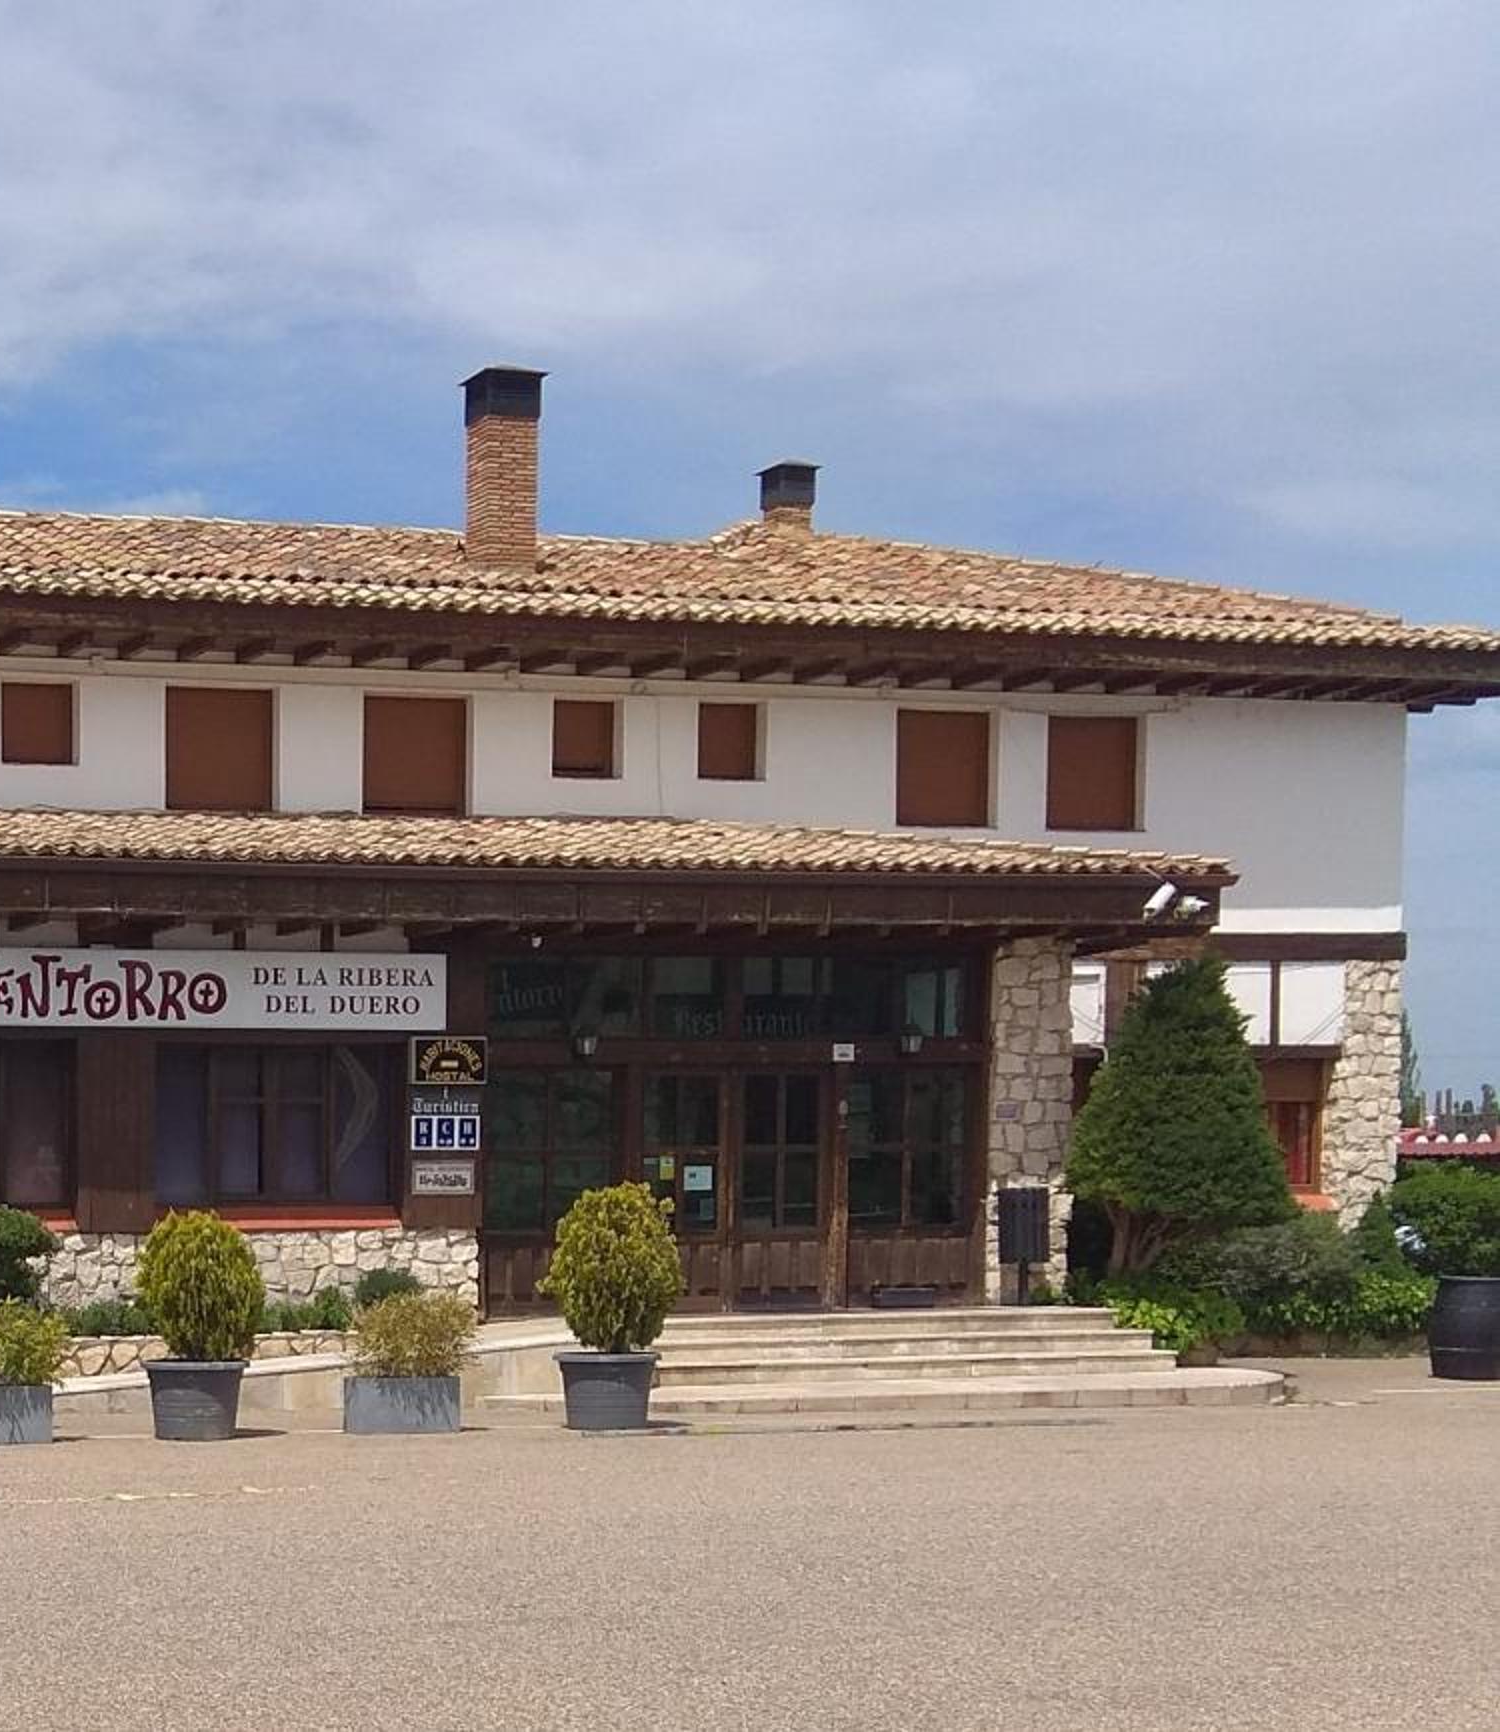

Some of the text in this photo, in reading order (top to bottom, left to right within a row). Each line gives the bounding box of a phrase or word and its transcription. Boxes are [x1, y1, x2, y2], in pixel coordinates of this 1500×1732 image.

[252, 966, 435, 988] DE LA RIBERA
[265, 995, 421, 1015] DEL DUERO
[426, 1070, 475, 1081] HOSTAL
